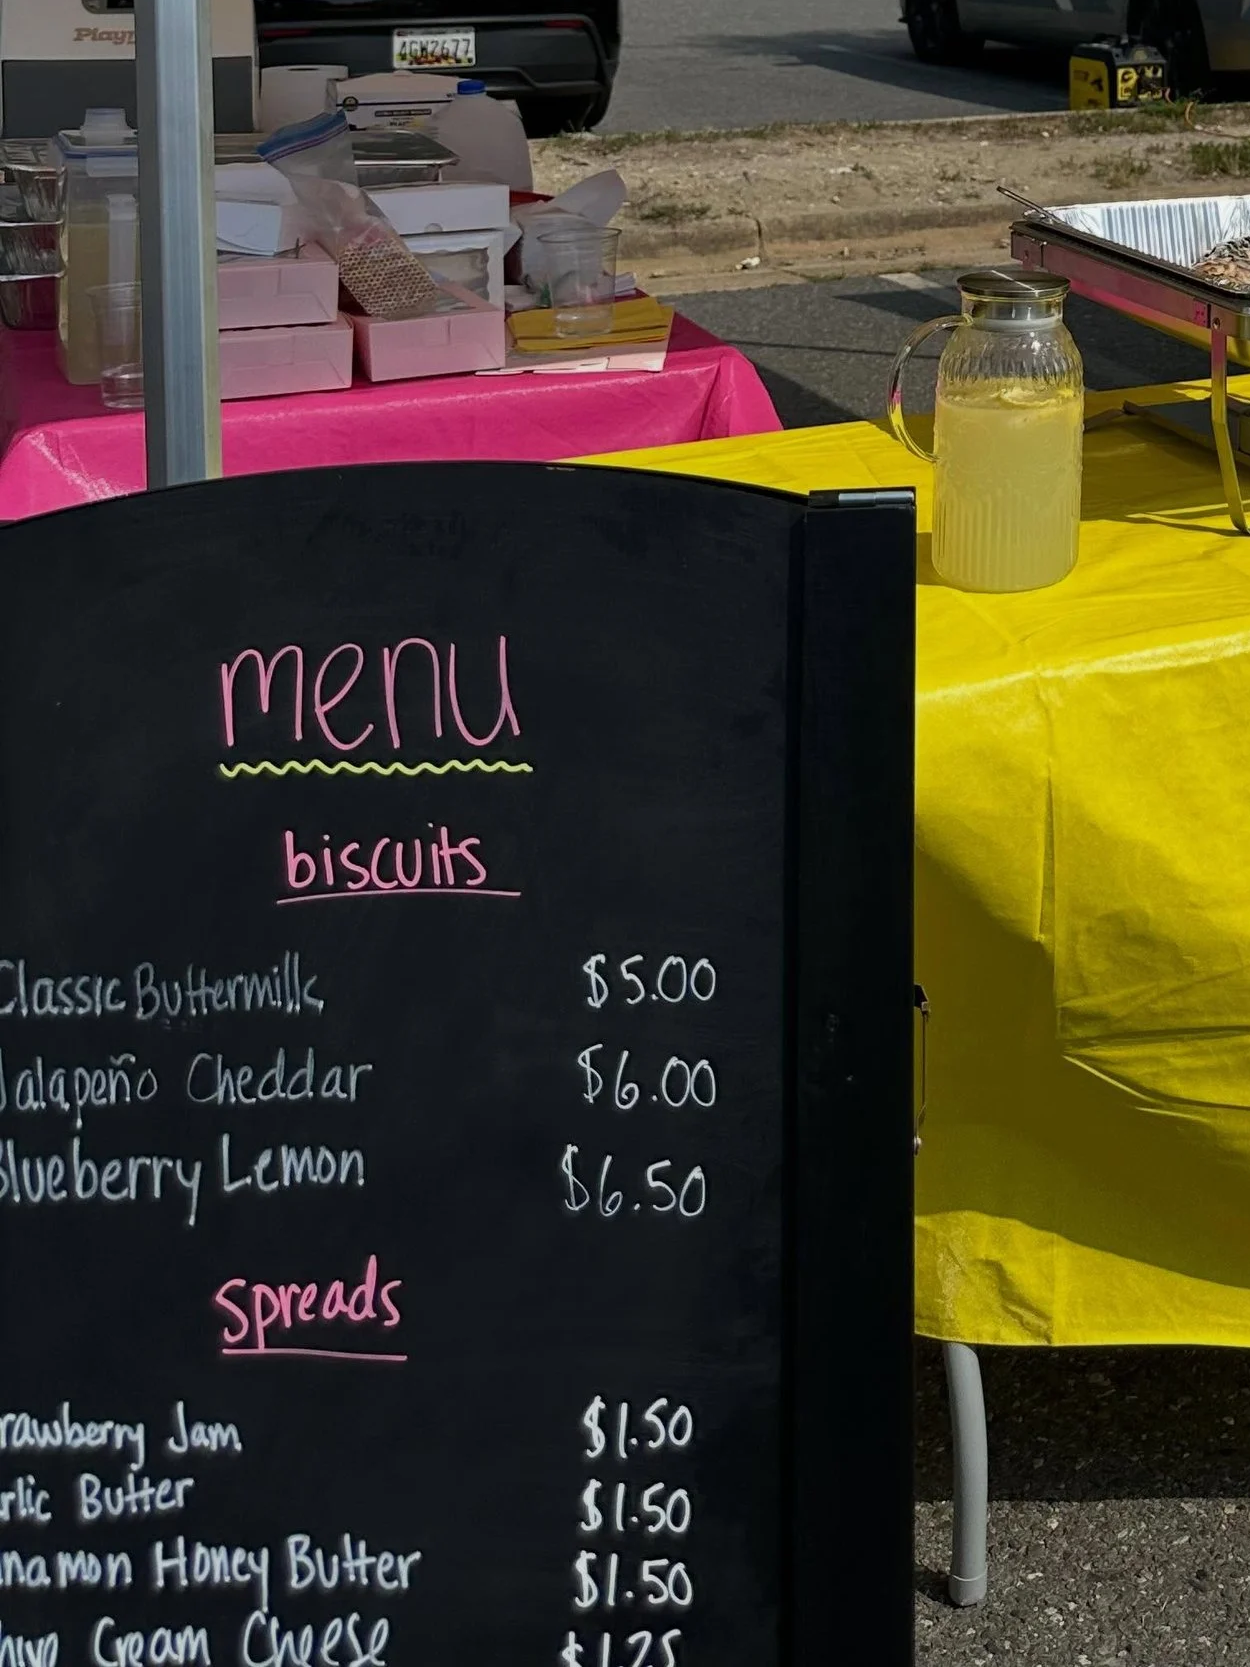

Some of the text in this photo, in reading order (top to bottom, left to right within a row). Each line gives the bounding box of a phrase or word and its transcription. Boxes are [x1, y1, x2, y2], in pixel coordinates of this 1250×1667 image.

[285, 822, 488, 890] biscuits
[134, 949, 325, 1020] Buttermilk
[583, 953, 716, 1008] $5.00
[186, 1047, 373, 1106] Cheddar
[577, 1043, 716, 1110] $6.00
[222, 1133, 366, 1192] Lemon
[562, 1144, 706, 1217] $6.50
[168, 1400, 242, 1453] Jam
[583, 1395, 693, 1458] $1.50
[79, 1472, 195, 1520] Butter
[581, 1479, 692, 1533] $1.50
[155, 1535, 270, 1612] Honey
[287, 1532, 422, 1590] Butter
[574, 1550, 693, 1608] $1.50
